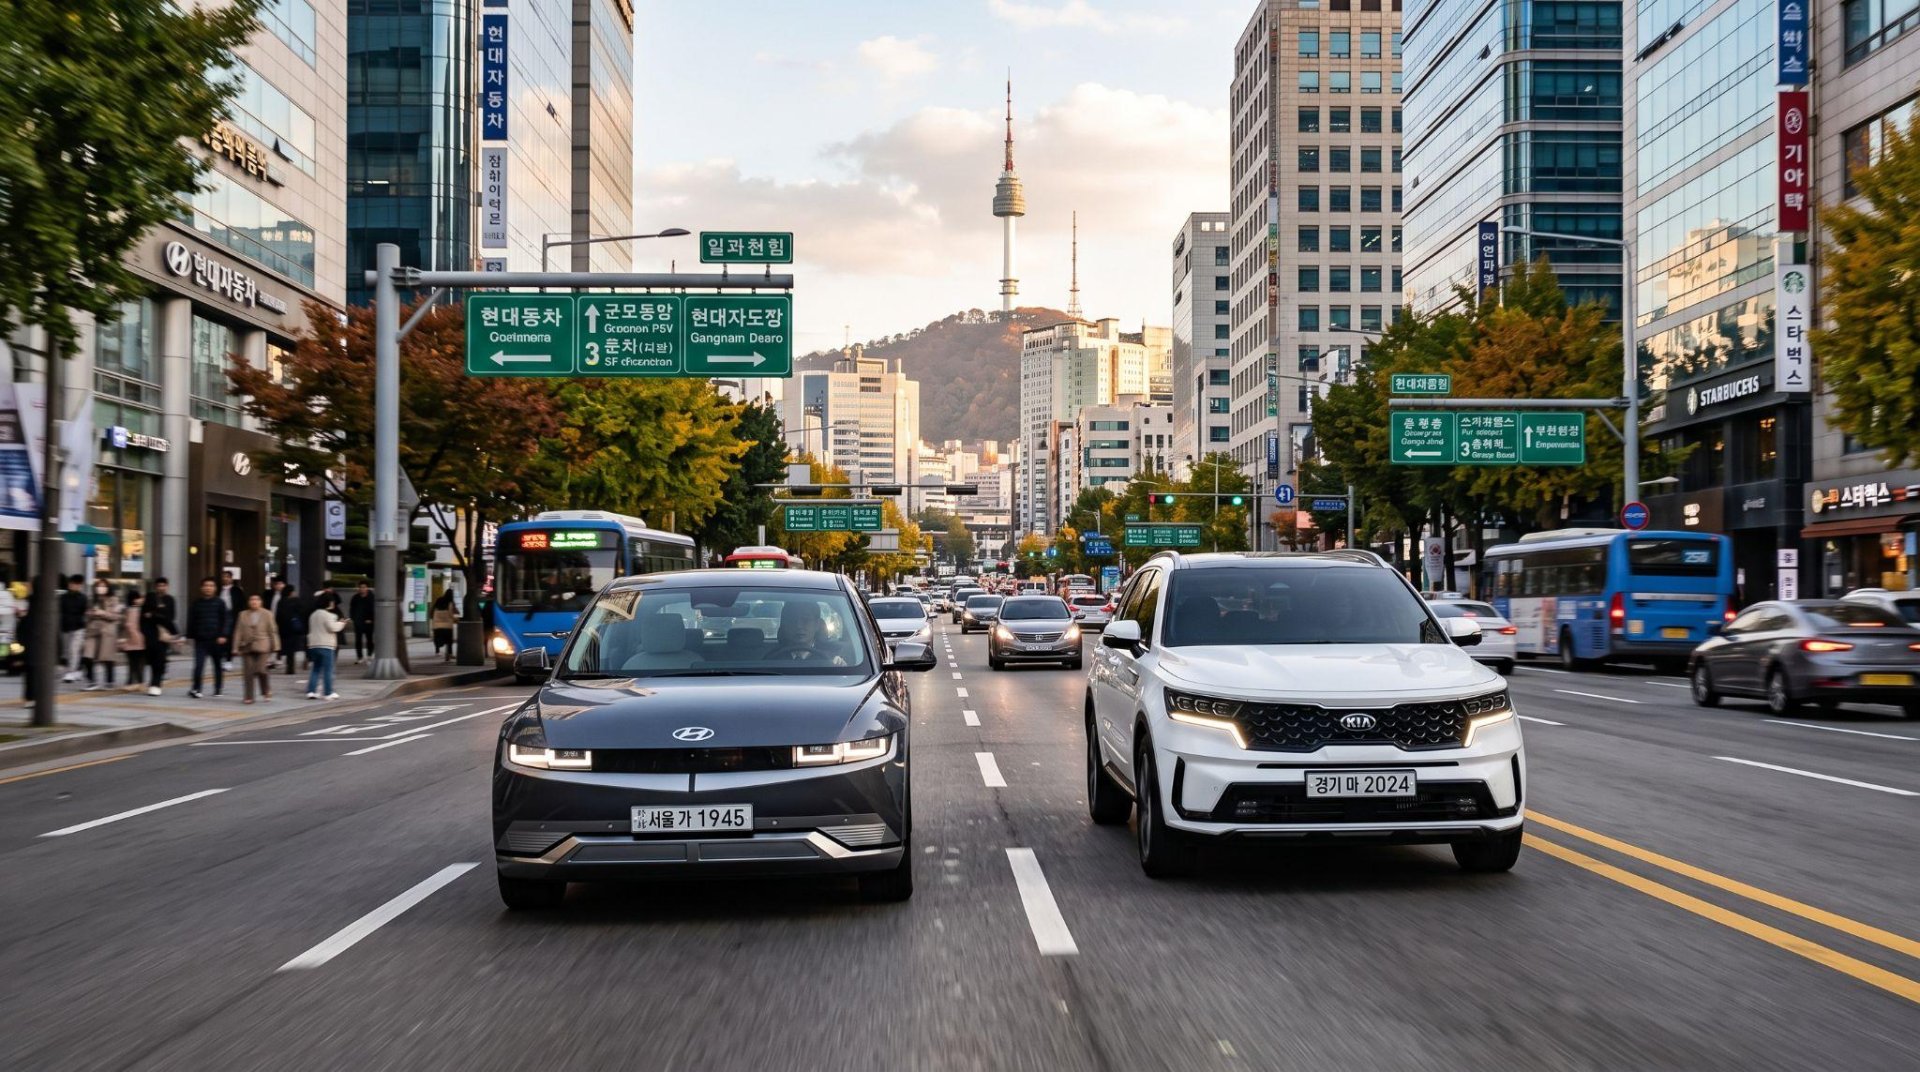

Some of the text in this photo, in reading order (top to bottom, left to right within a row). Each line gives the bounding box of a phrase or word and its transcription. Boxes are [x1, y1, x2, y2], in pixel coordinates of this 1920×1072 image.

[487, 25, 504, 129] 현대자동차
[193, 251, 257, 308] 현대자동차
[481, 307, 562, 327] 현대동차
[604, 303, 673, 321] 군모동암
[691, 308, 784, 328] 현대자도장
[652, 323, 673, 333] PSV
[690, 332, 784, 345] Gangnam Dearo
[1786, 305, 1805, 385] 스타벅스
[585, 341, 600, 366] 3
[604, 357, 618, 366] SF
[1460, 441, 1470, 457] 3
[1346, 717, 1372, 728] KIA
[1315, 775, 1410, 794] 경기 마 2024
[649, 810, 675, 828] 서울
[678, 810, 692, 828] 가
[698, 808, 745, 827] 1945
